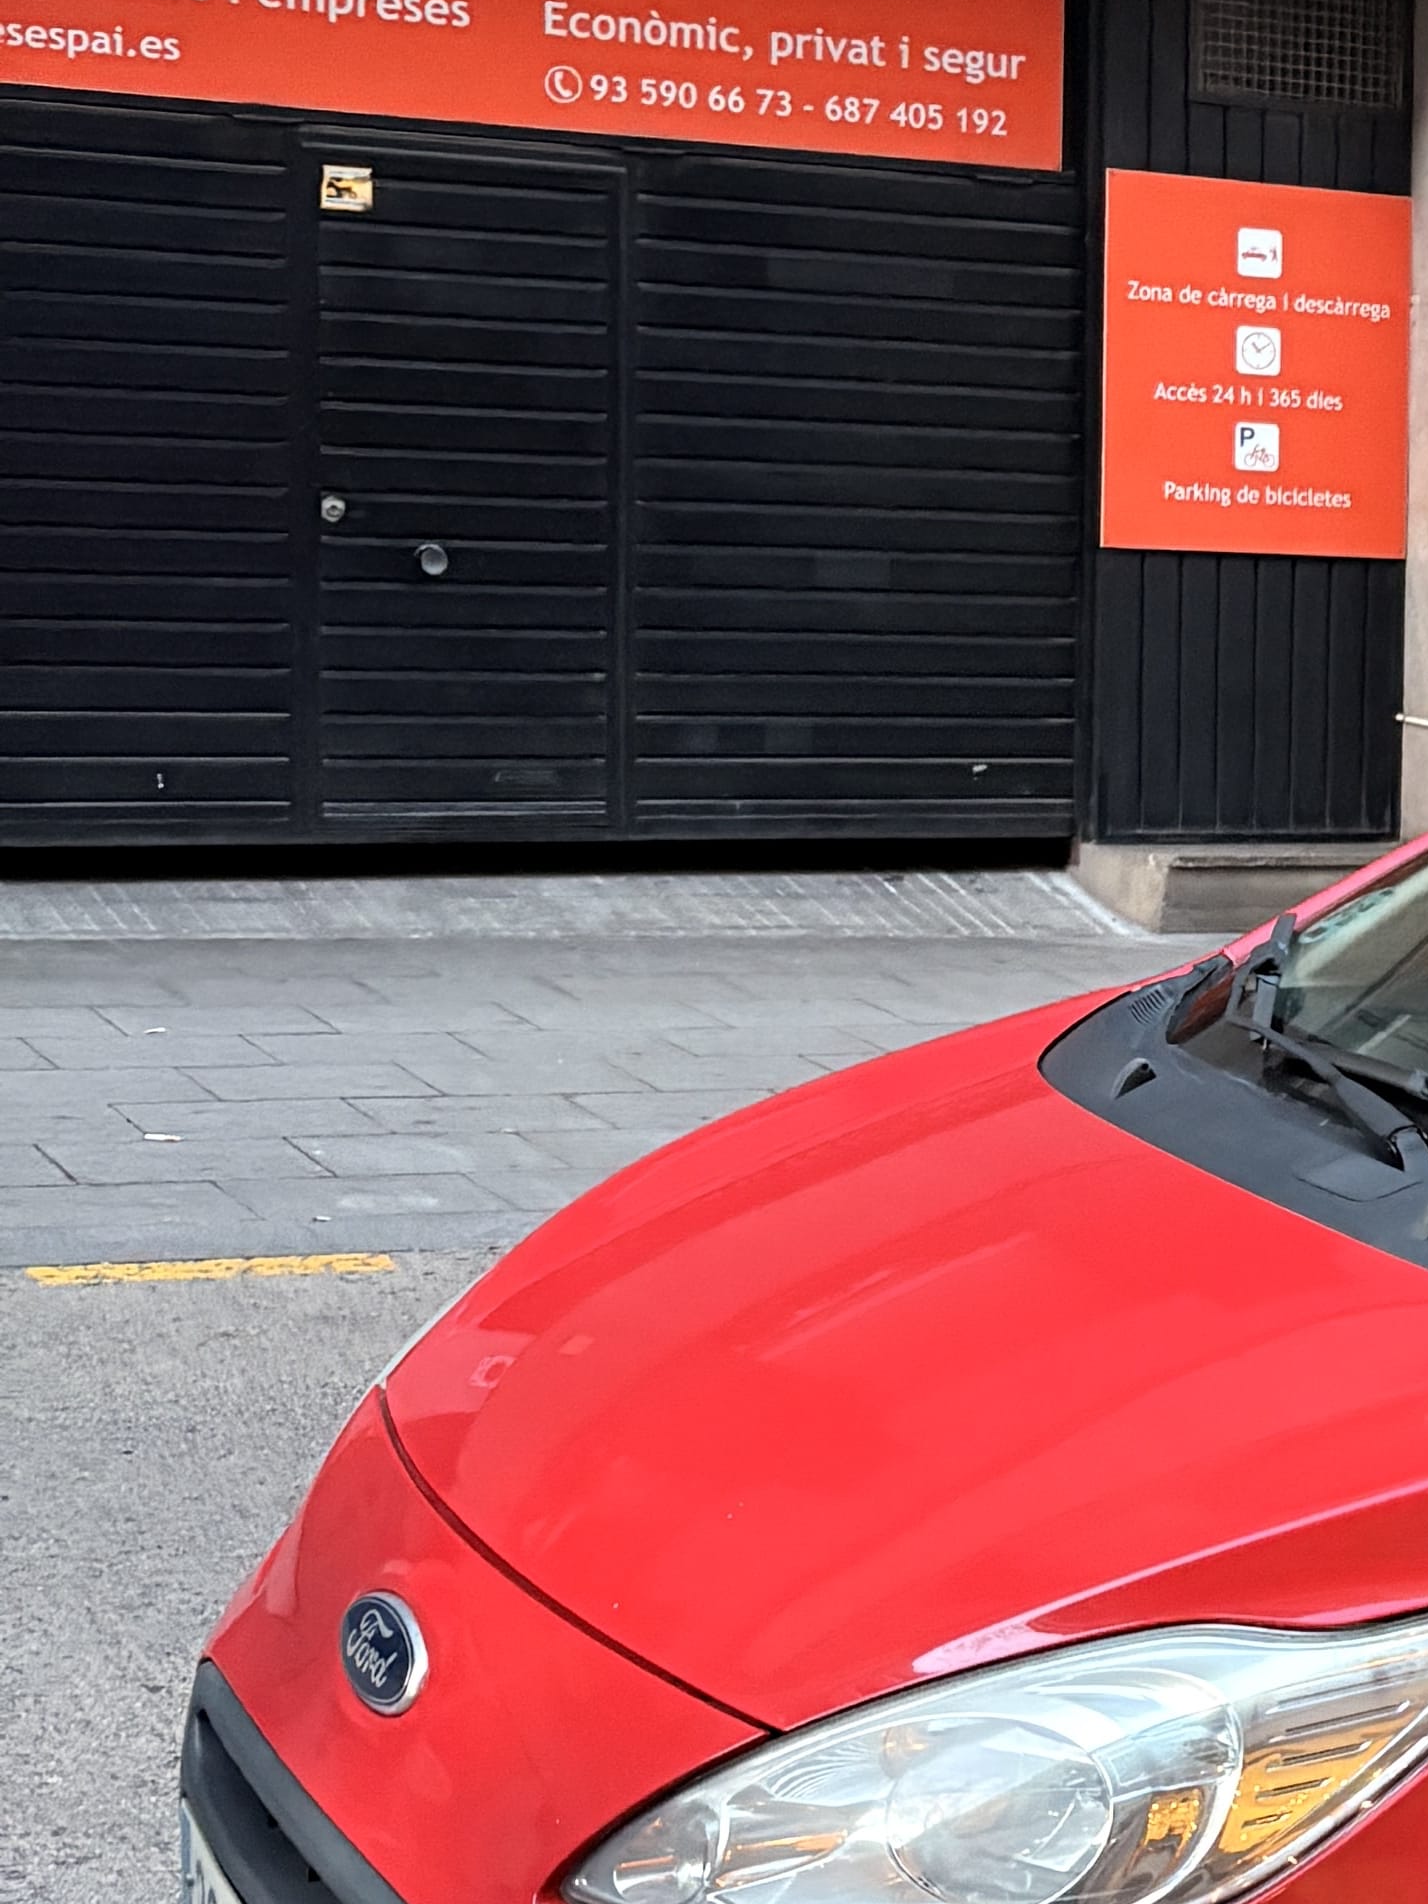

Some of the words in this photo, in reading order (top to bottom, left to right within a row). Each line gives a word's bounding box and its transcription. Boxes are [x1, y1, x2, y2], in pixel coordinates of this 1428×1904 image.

[0, 22, 181, 61] sespai.es
[544, 0, 754, 61] Econòmic,
[770, 26, 887, 68] privat
[898, 35, 910, 69] i
[923, 44, 1026, 85] segur
[589, 74, 628, 103] 93
[640, 78, 698, 109] 590
[707, 84, 745, 114] 66
[755, 88, 792, 117] 73
[824, 94, 881, 125] 687
[889, 100, 944, 131] 405
[956, 107, 1008, 137] 192
[1127, 279, 1173, 303] Zona
[1178, 283, 1203, 305] de
[1212, 383, 1235, 405] 24
[1239, 385, 1252, 406] h
[1269, 387, 1302, 409] 365
[1305, 389, 1344, 412] dies
[1239, 427, 1255, 447] P
[1163, 480, 1232, 508] Parking
[1235, 484, 1260, 505] de
[1264, 485, 1352, 509] bicicletes
[346, 1608, 398, 1688] Ford
